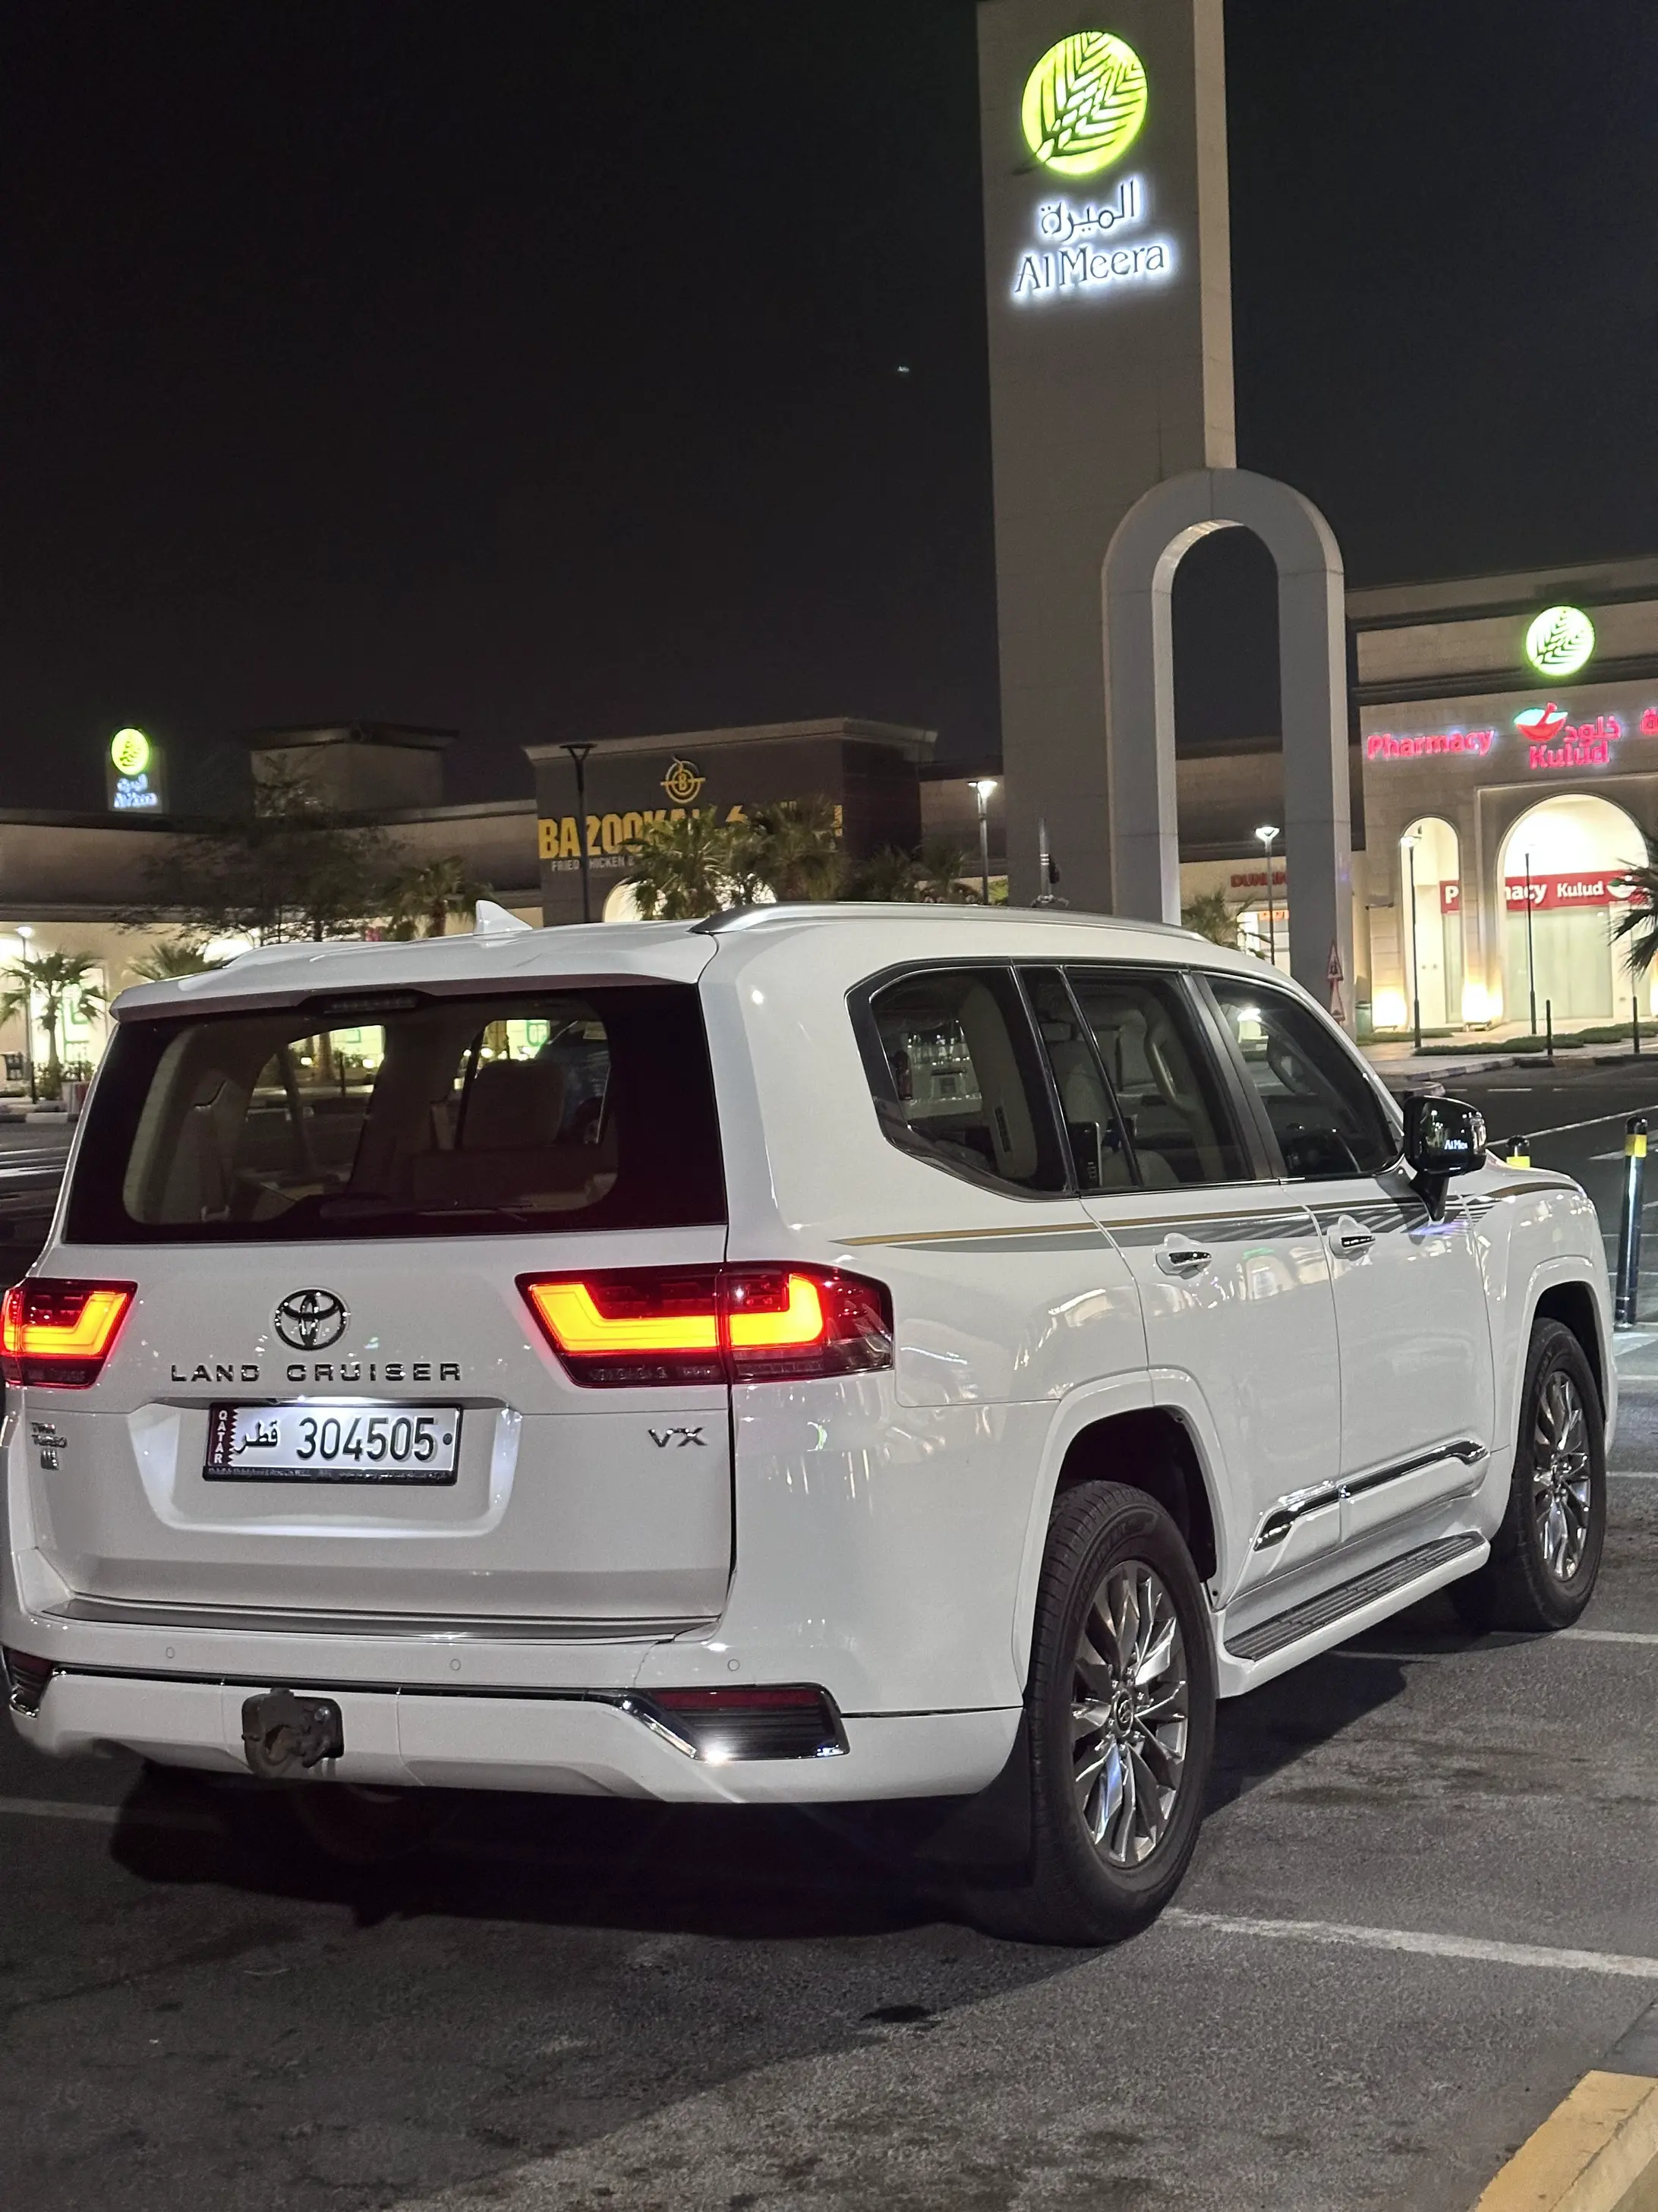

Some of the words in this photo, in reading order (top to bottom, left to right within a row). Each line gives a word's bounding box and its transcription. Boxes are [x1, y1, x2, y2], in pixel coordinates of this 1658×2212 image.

[1040, 179, 1136, 242] الميرة
[1013, 254, 1051, 293] Al
[1058, 245, 1165, 287] Meera
[1366, 729, 1495, 760] Pharmacy
[1529, 740, 1610, 770] Kulud
[1562, 715, 1622, 748] خلود
[537, 808, 686, 860] BAZOO
[582, 856, 626, 869] HICKEN
[1557, 881, 1604, 898] Kulud
[171, 1364, 260, 1382] LAND
[286, 1362, 462, 1382] CRUISER
[213, 1409, 229, 1465] QATAR
[232, 1418, 281, 1455] قطر
[295, 1416, 437, 1462] 304505
[648, 1427, 708, 1448] VX
